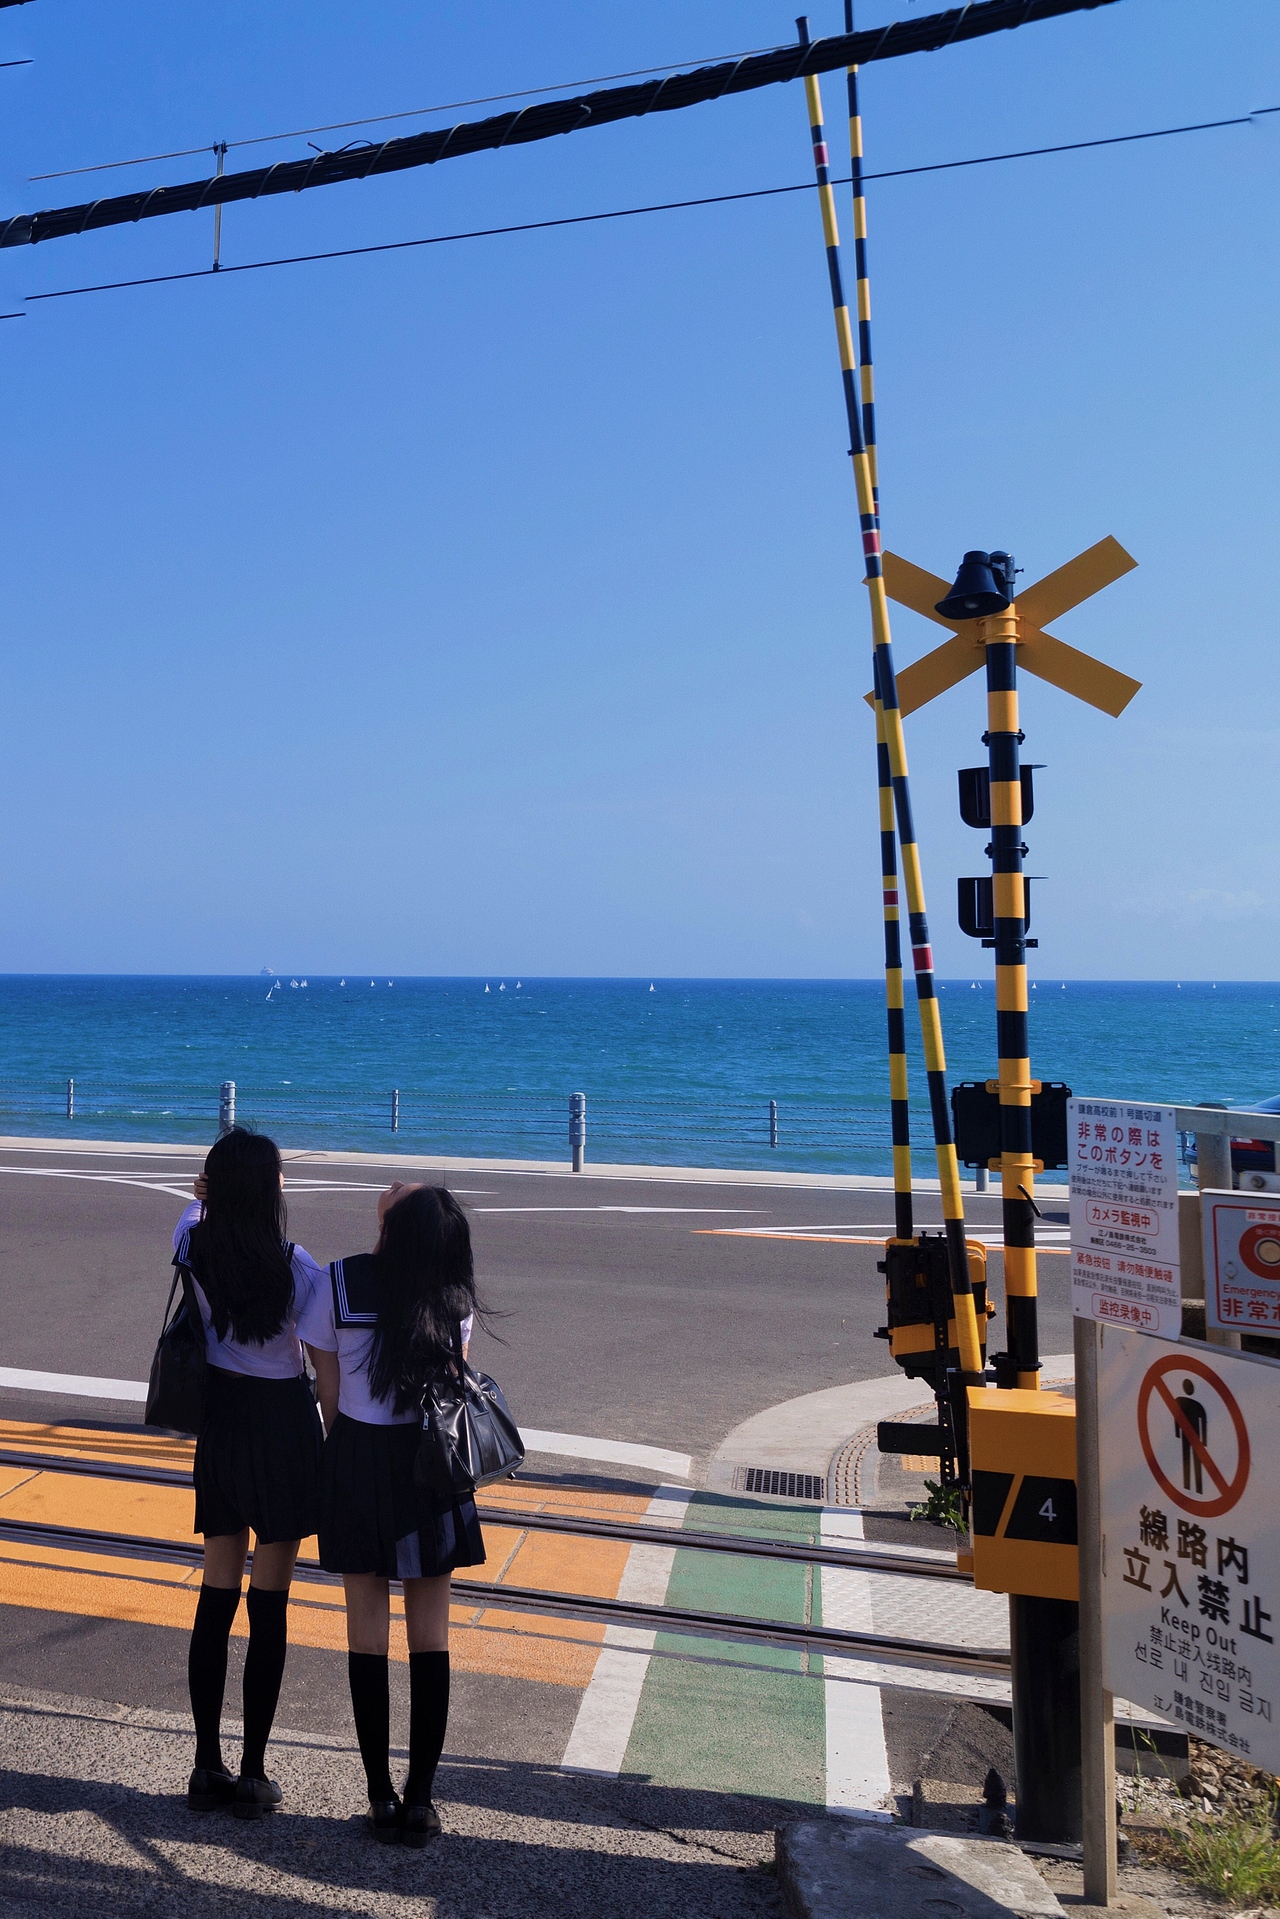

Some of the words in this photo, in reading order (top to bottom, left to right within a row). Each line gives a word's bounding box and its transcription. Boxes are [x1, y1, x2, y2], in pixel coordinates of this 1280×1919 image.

[1078, 1122, 1160, 1147] 非常の際は
[1078, 1143, 1162, 1170] このボタンを
[1092, 1206, 1151, 1229] カメラ監視中
[1076, 1252, 1111, 1270] 紧急按钮
[1099, 1298, 1152, 1325] 监控录像中
[1038, 1497, 1057, 1522] 4
[1139, 1504, 1249, 1585] 線路内
[1123, 1546, 1274, 1644] 立入禁止
[1161, 1606, 1201, 1642] Keep
[1206, 1627, 1237, 1656] Out
[1150, 1625, 1252, 1687] 禁止进入线路内
[1134, 1641, 1164, 1670] 선로
[1173, 1659, 1189, 1683] 내
[1199, 1670, 1230, 1703] 진입
[1238, 1688, 1272, 1723] 금지
[1154, 1694, 1251, 1754] 江ノ島電鉄株式会社
[1173, 1690, 1228, 1727] 鎌倉警察署
